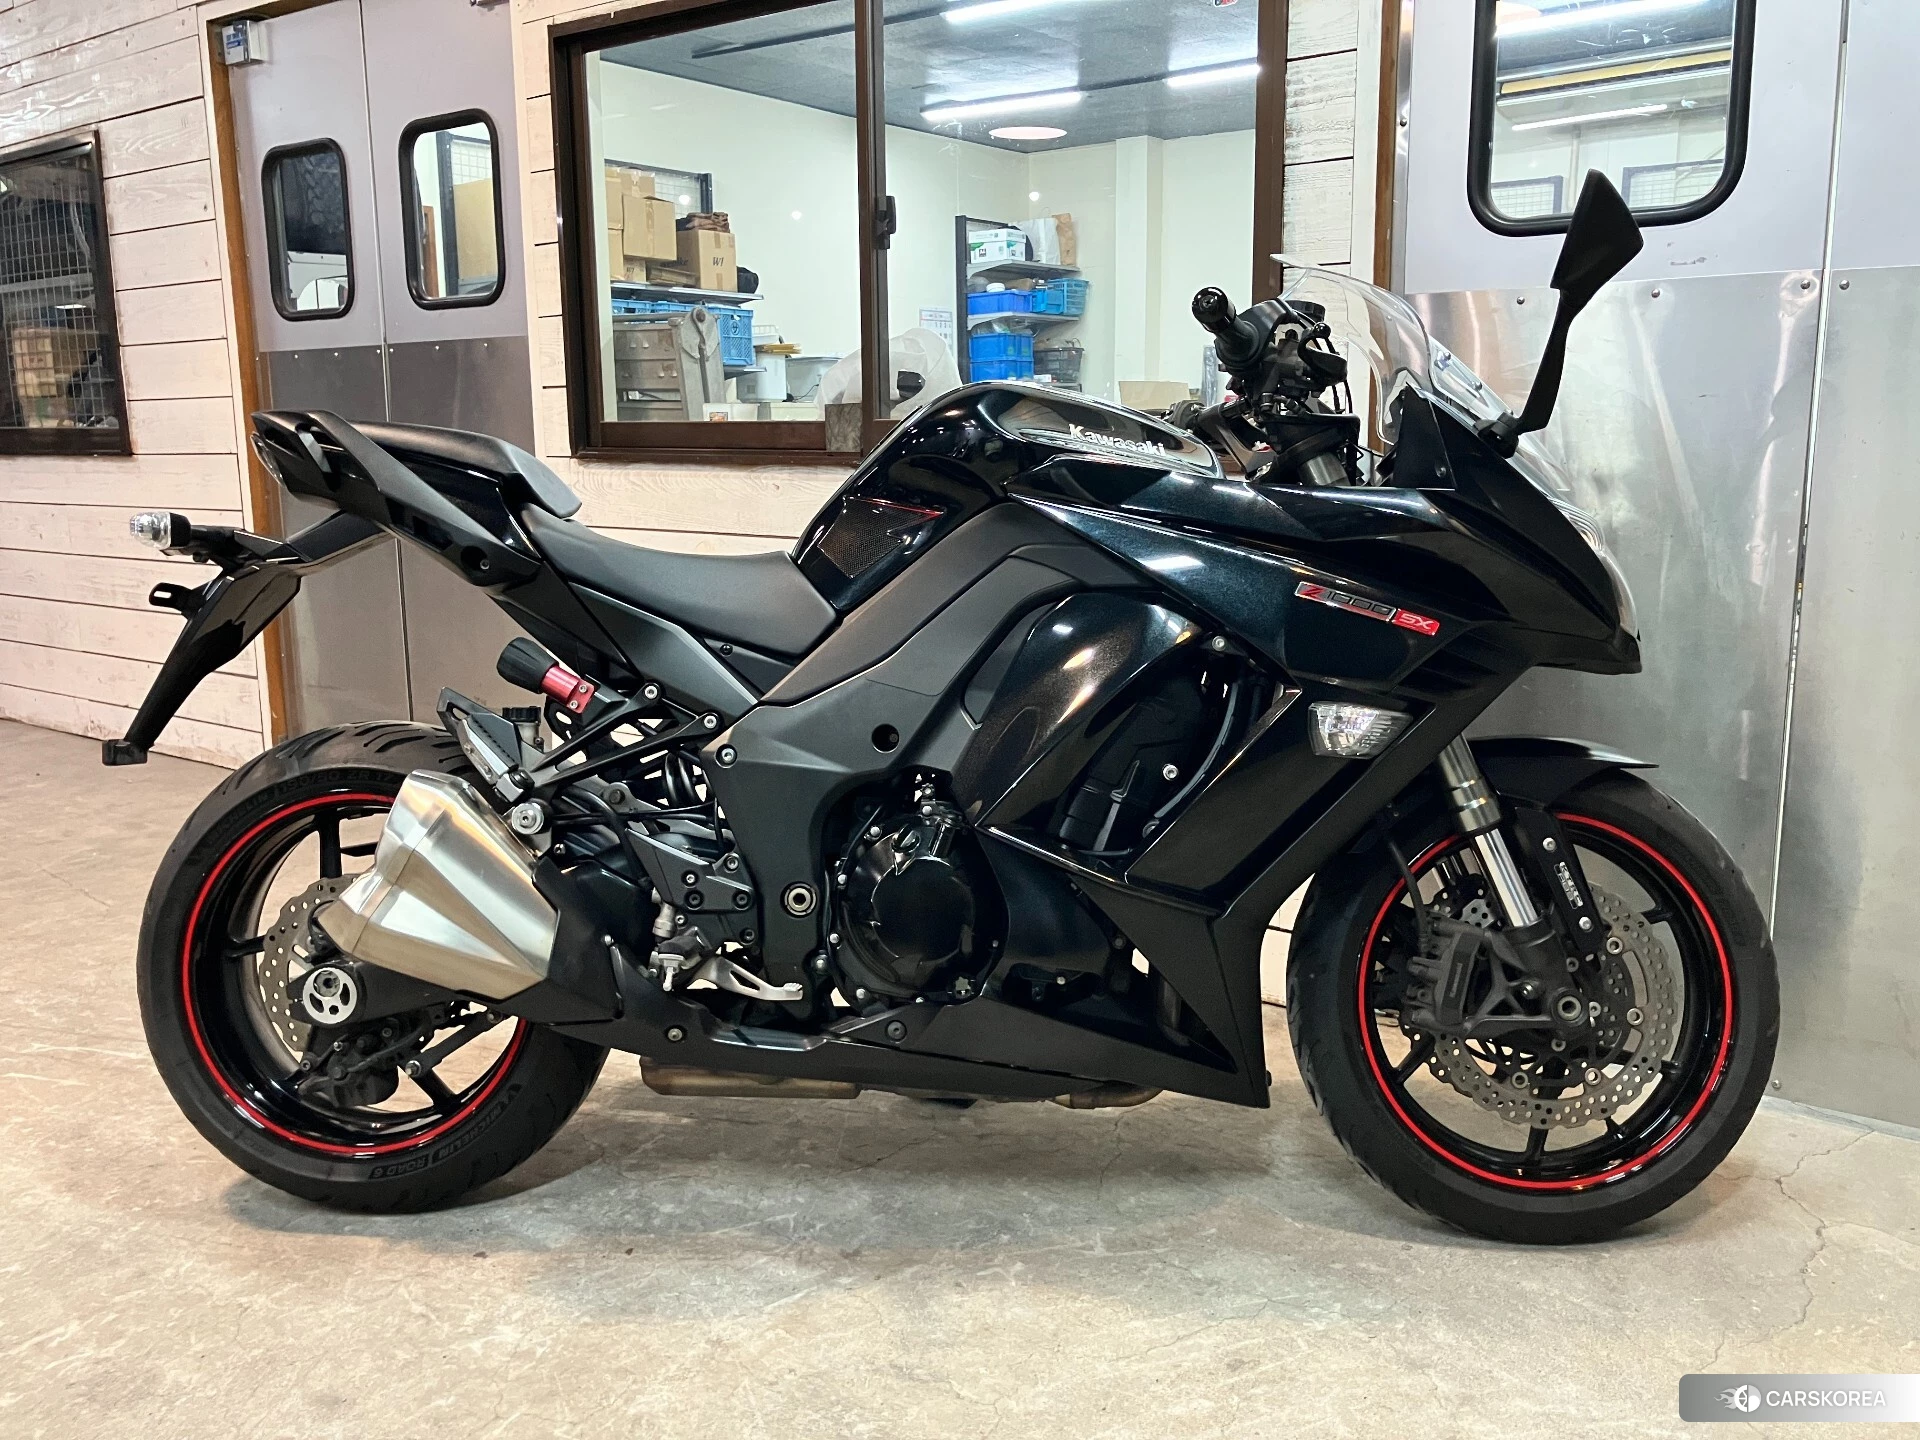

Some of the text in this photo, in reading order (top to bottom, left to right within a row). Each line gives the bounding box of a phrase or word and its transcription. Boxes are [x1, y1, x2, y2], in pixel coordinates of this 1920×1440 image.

[1068, 423, 1167, 457] Kawasaki
[1301, 586, 1434, 630] Z1000 SX
[387, 1155, 426, 1176] ROAD
